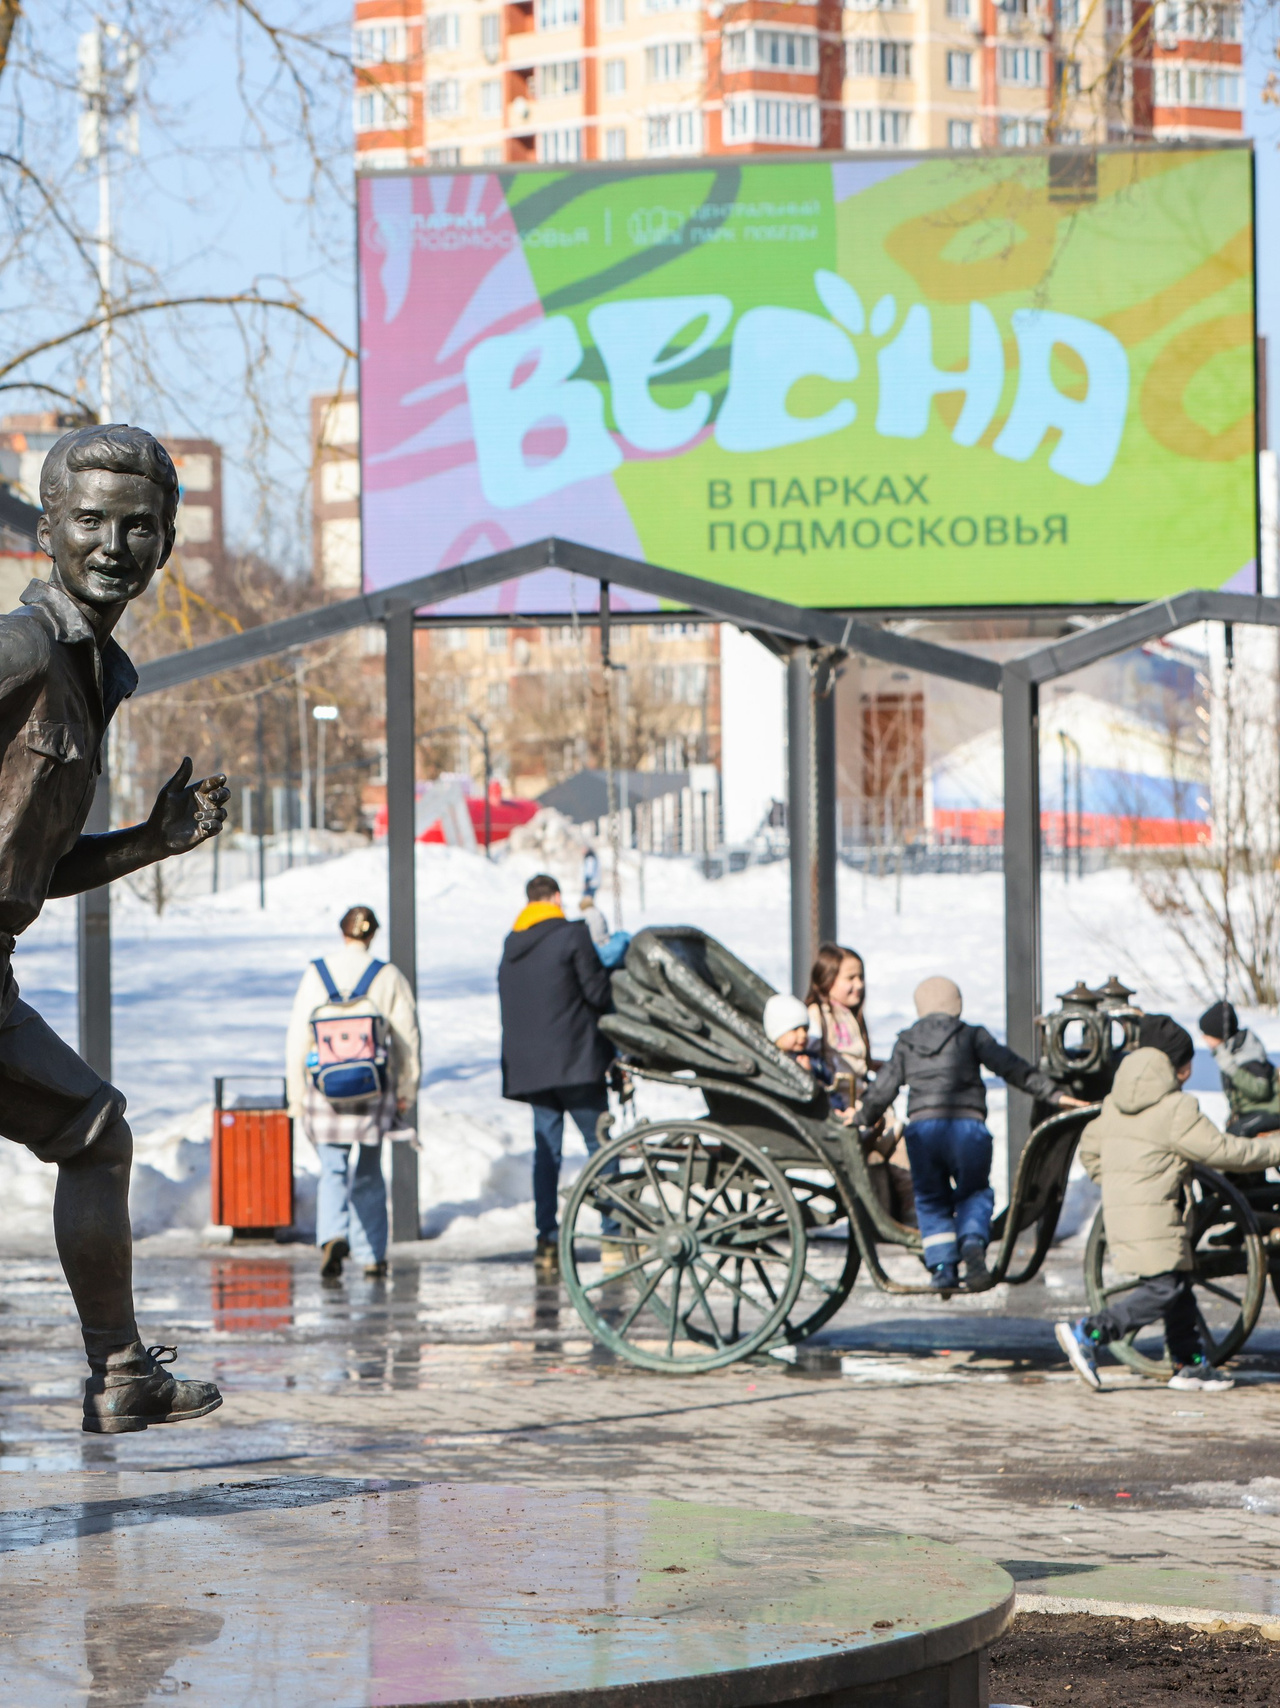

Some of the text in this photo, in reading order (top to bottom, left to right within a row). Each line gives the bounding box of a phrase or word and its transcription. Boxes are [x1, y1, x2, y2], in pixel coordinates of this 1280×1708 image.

[708, 474, 930, 510] В ПАРКАХ
[708, 514, 1069, 556] ПОДМОСКОВЬЯ
